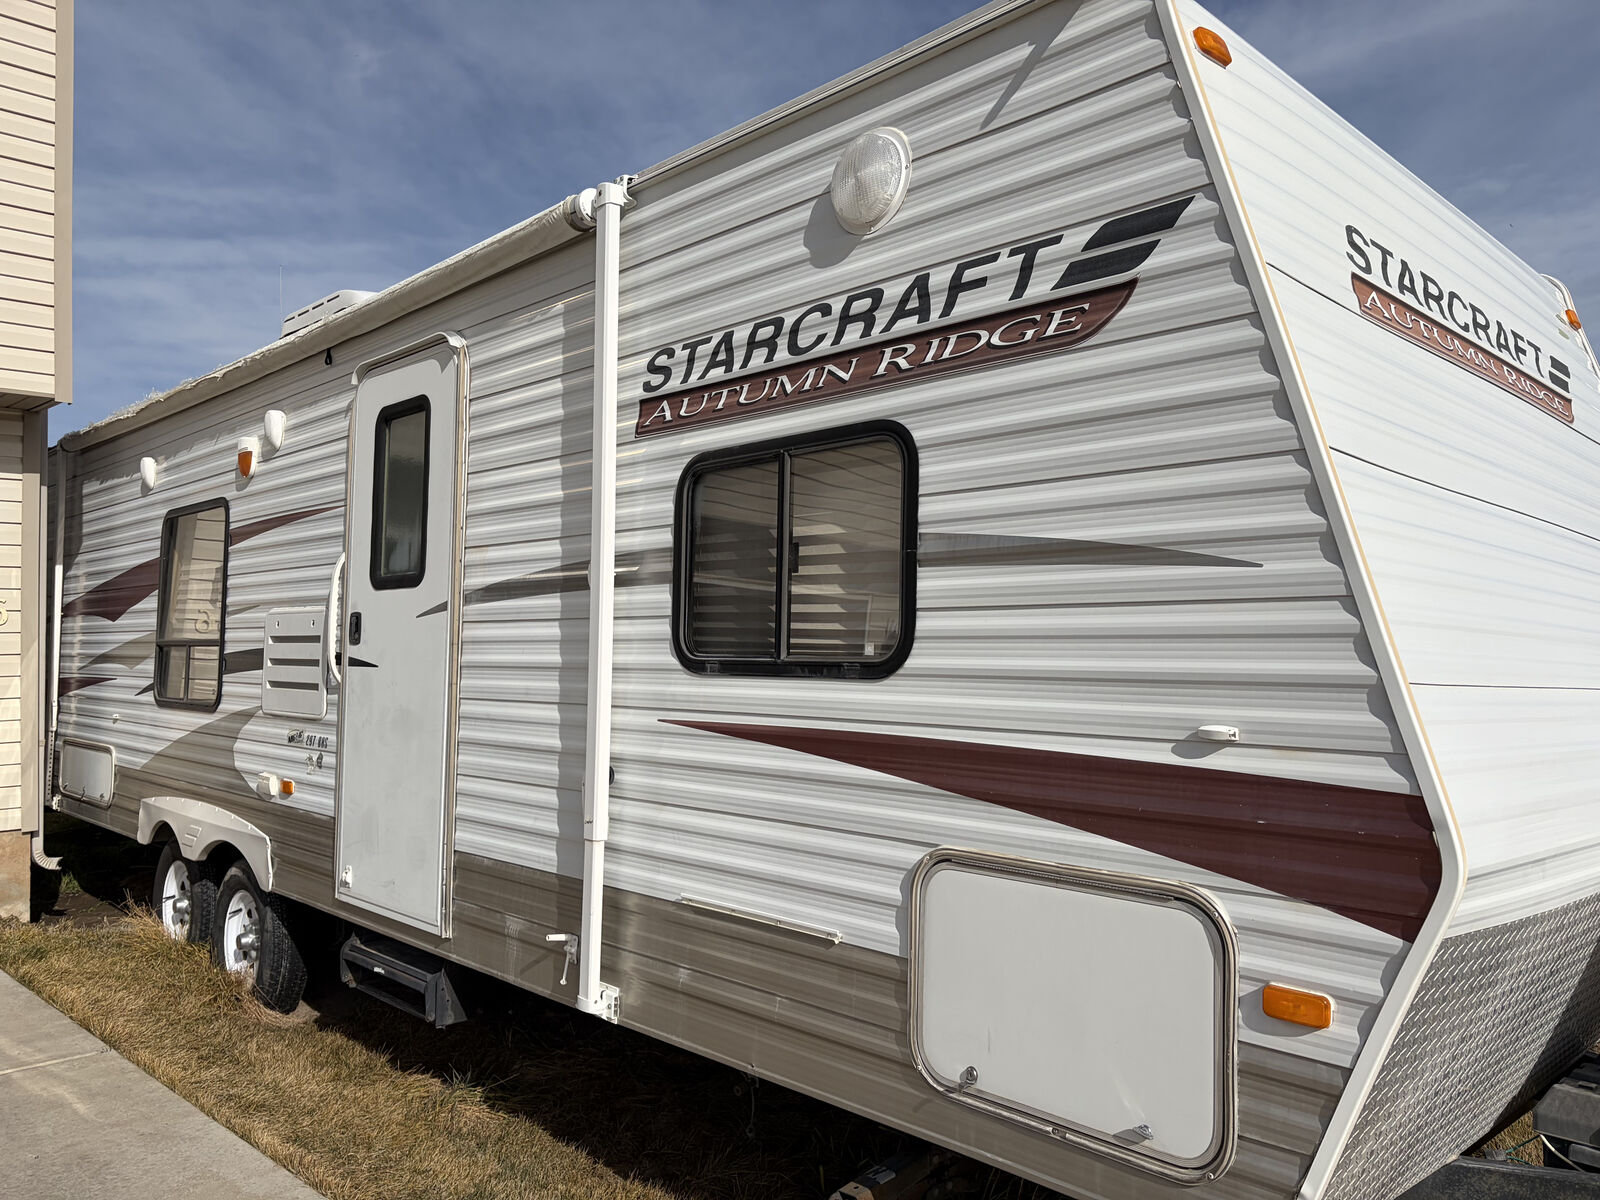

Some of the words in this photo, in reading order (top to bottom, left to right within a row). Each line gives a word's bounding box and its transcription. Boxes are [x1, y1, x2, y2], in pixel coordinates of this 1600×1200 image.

[641, 355, 857, 428] AUTUMN
[873, 302, 1090, 379] RIDGE
[643, 233, 1063, 393] STARCRAFT
[1345, 224, 1545, 378] STARCRAFT
[1364, 291, 1500, 375] AUTUMN
[1502, 364, 1570, 416] RIDGE
